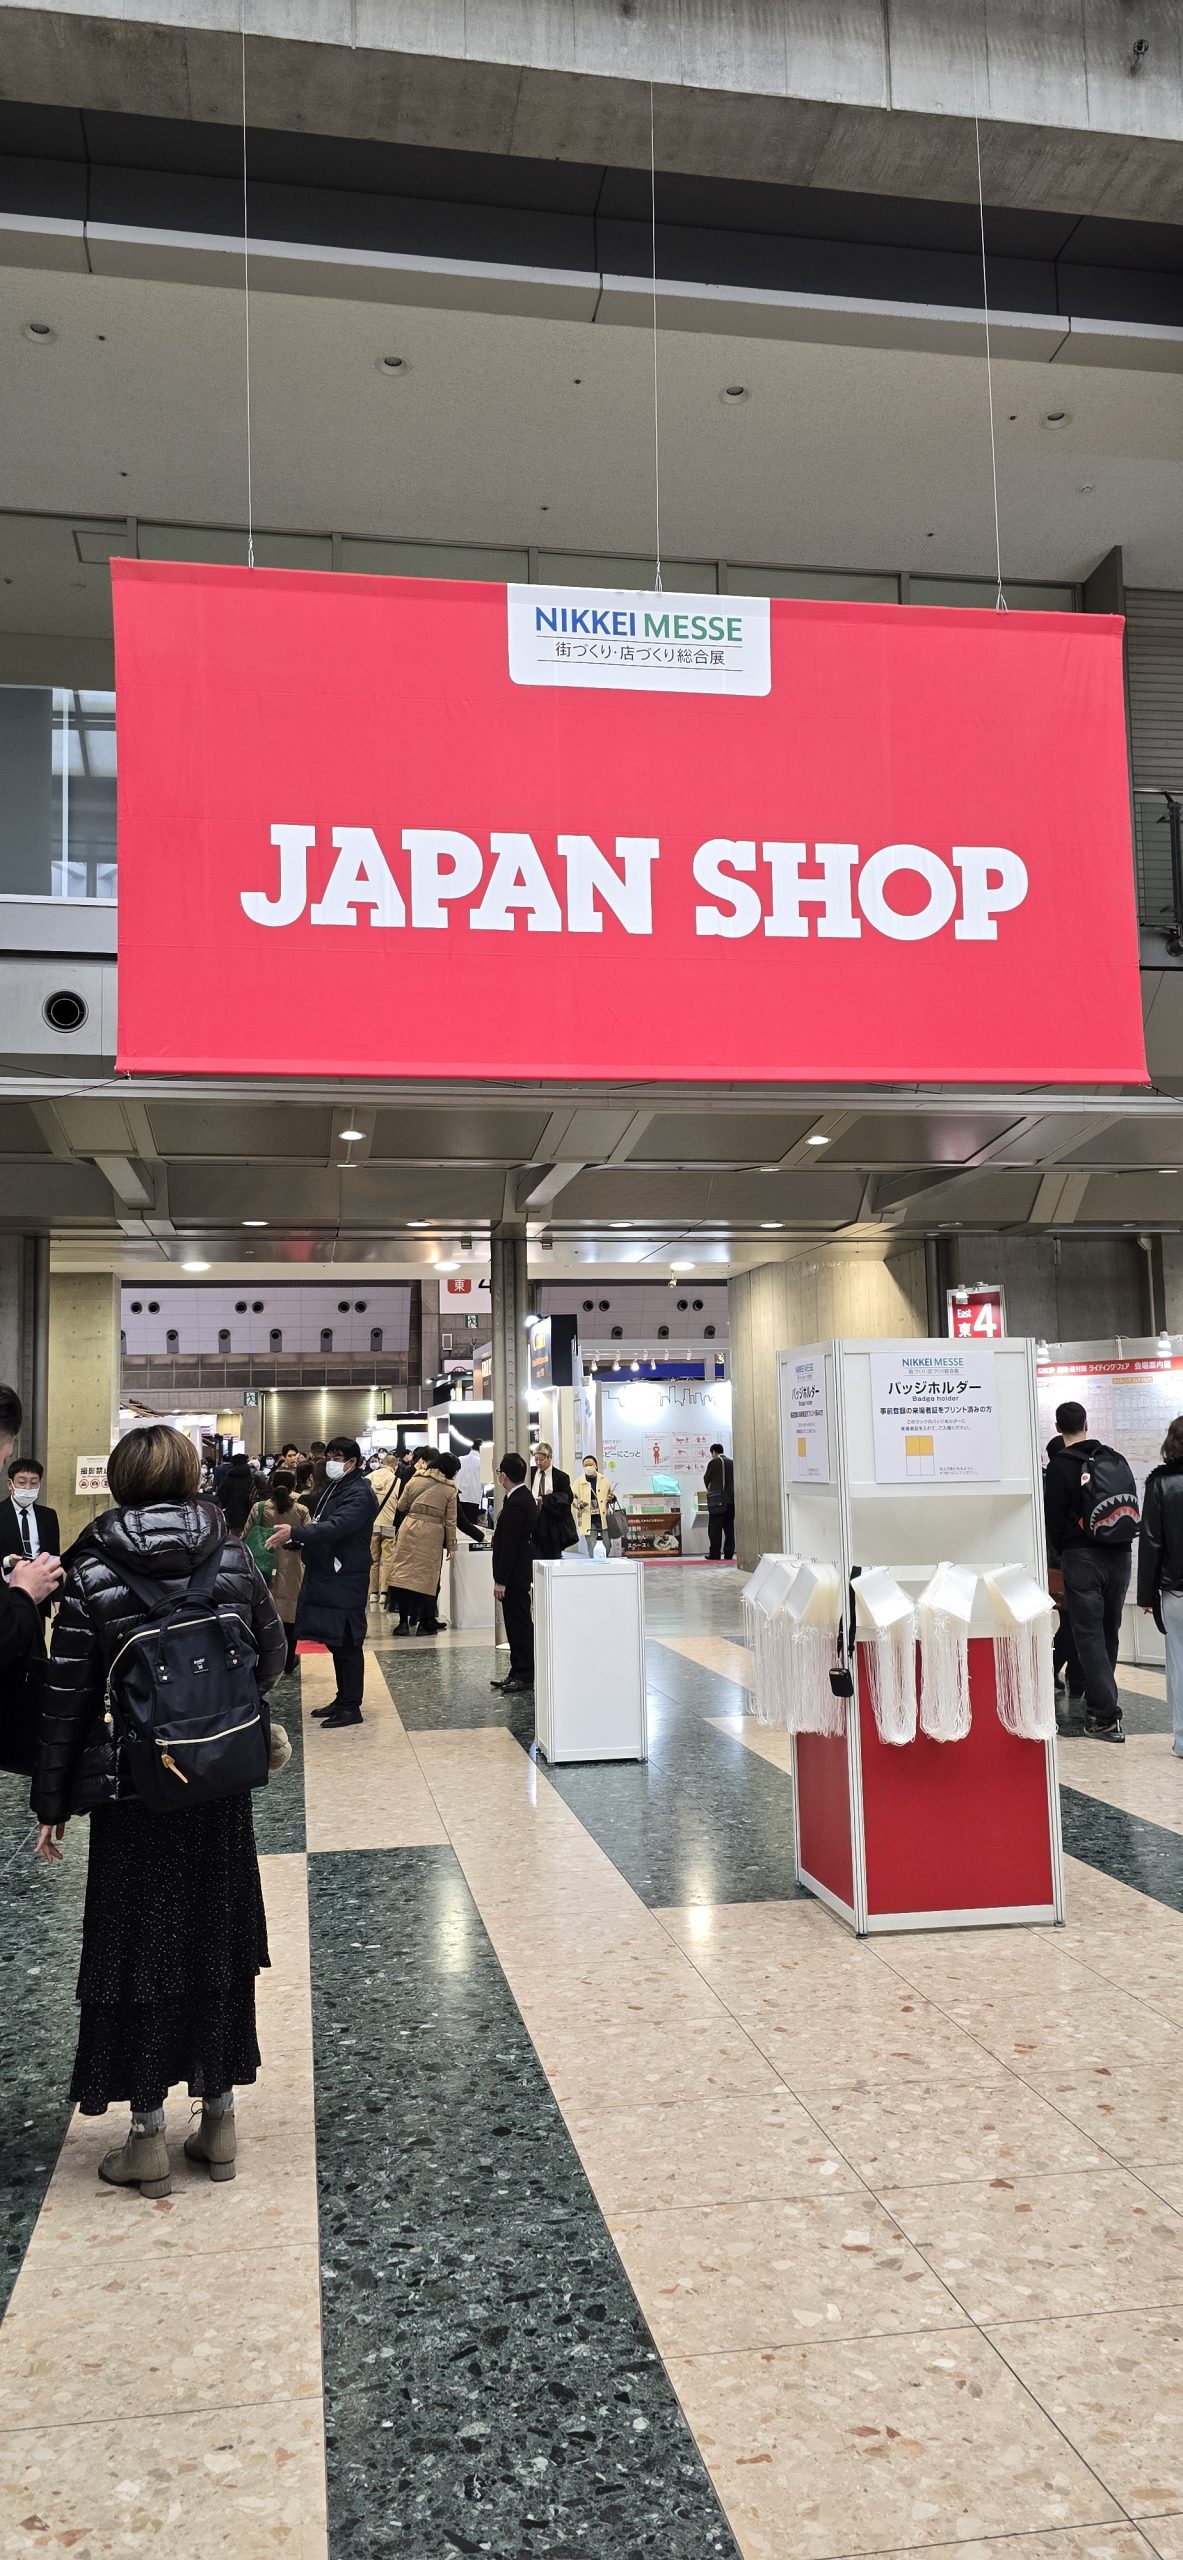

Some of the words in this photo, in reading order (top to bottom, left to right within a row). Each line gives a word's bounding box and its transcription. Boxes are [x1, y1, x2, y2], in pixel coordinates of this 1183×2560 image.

[535, 606, 636, 637] NIKKEI
[644, 613, 743, 642] MESSE
[555, 641, 726, 665] 街づくり・店づくり総合展
[240, 823, 660, 935] JAPAN
[692, 838, 1030, 941] SHOP
[957, 1308, 972, 1319] East
[973, 1302, 998, 1338] 4
[958, 1322, 972, 1338] 東
[902, 1358, 932, 1367] NIKKEI
[934, 1357, 964, 1366] MESSE
[888, 1380, 982, 1395] バッジホルダー
[912, 1395, 935, 1403] Badge
[880, 1405, 992, 1416] 事前登録の来場者証をプリント済みの方
